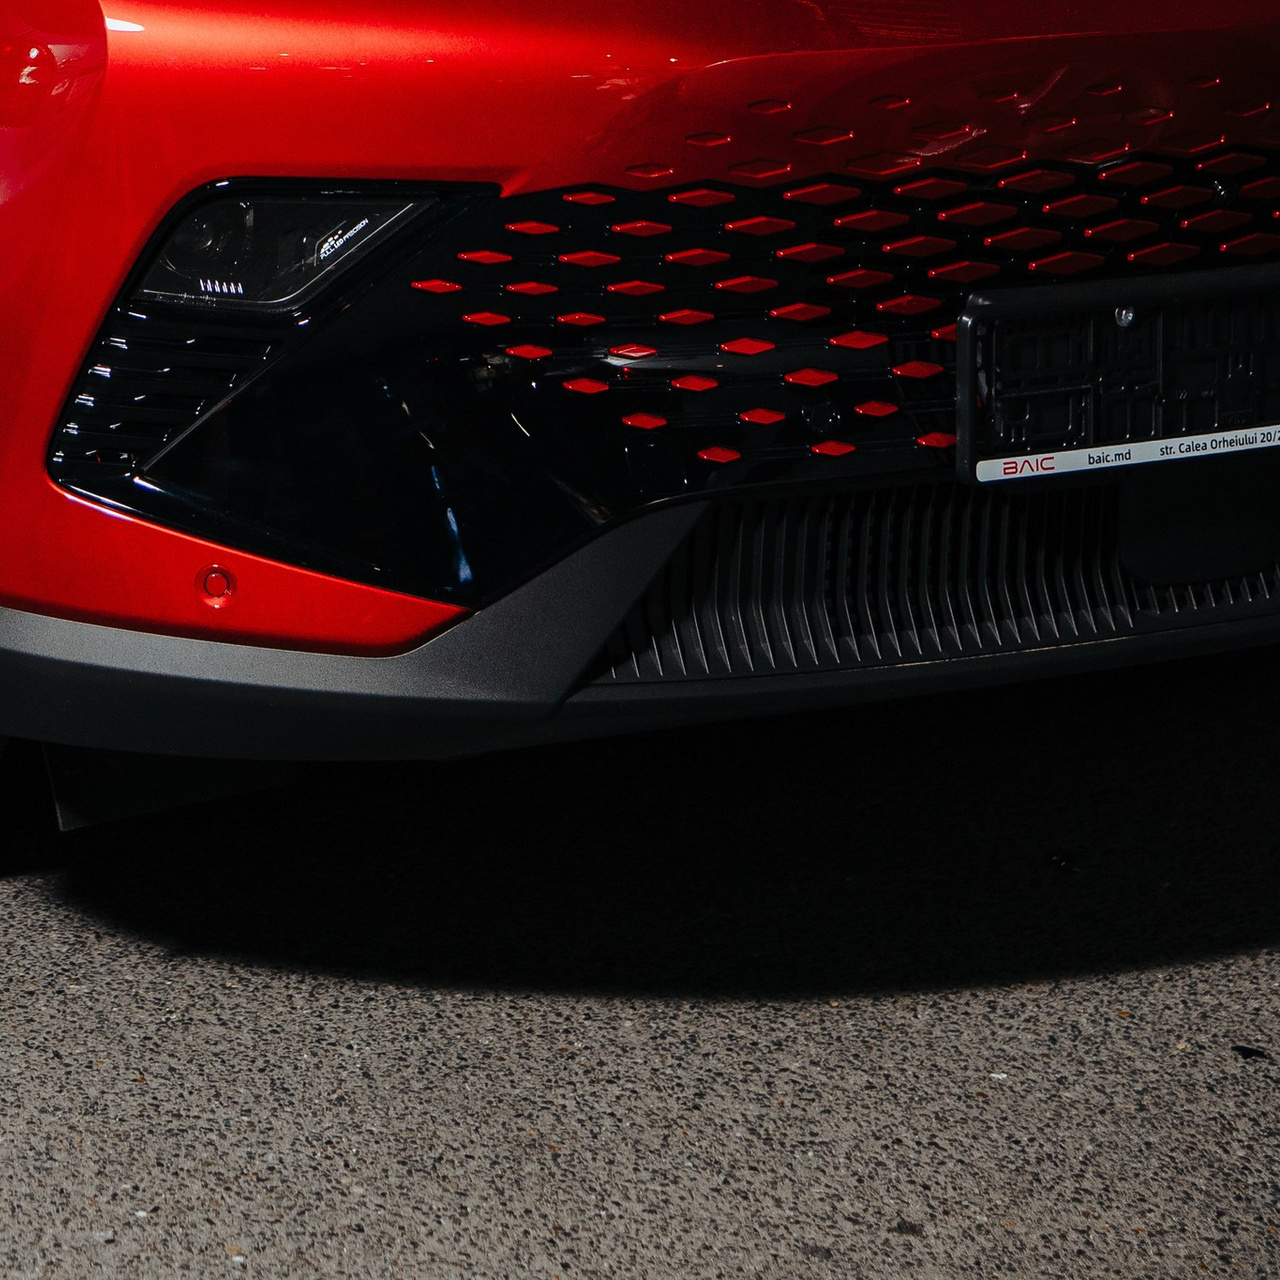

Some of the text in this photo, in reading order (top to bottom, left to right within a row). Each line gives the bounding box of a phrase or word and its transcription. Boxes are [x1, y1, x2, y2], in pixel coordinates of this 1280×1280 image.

[1159, 446, 1176, 457] str.
[1178, 440, 1208, 454] Calea
[1210, 433, 1258, 450] Orheiului
[1002, 456, 1056, 476] BAIC
[1087, 448, 1132, 466] baic.md
